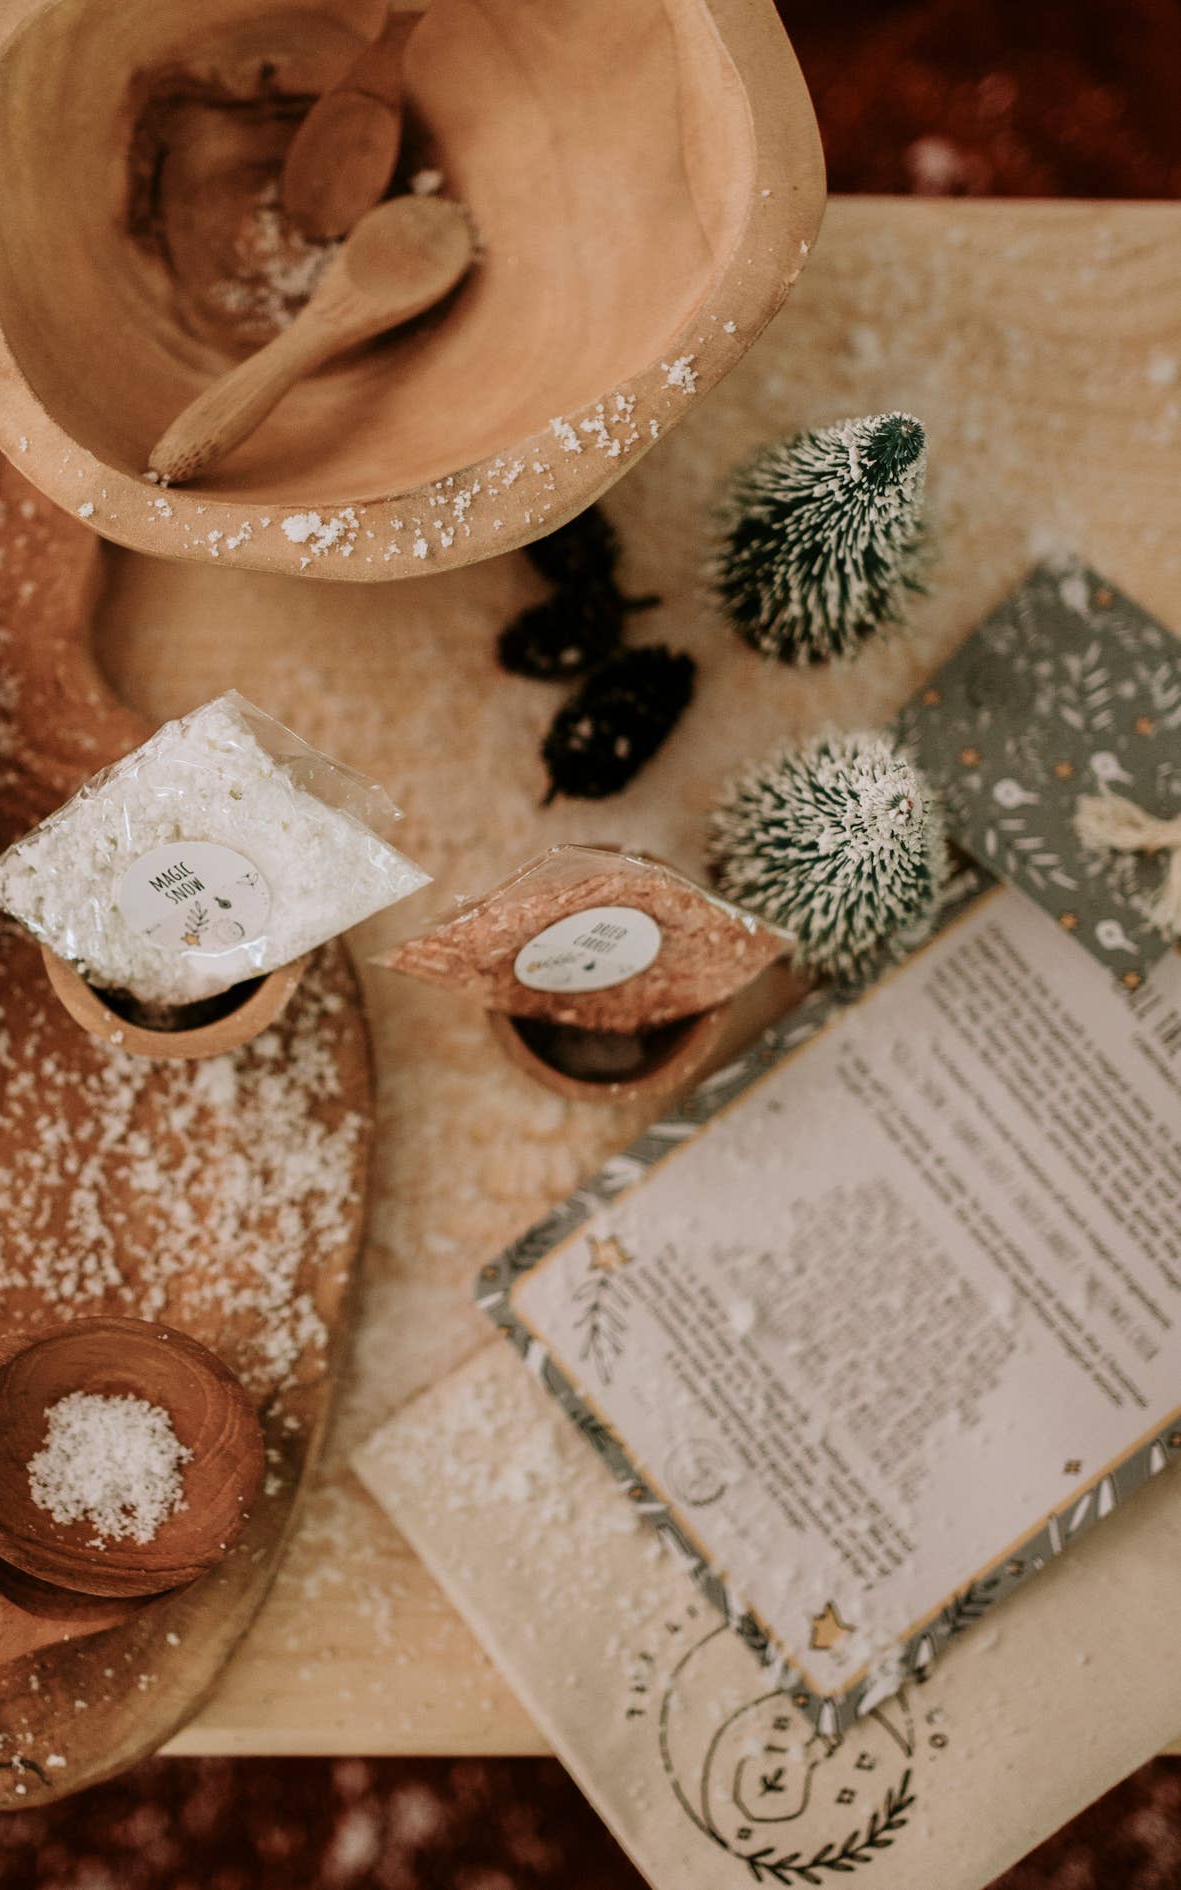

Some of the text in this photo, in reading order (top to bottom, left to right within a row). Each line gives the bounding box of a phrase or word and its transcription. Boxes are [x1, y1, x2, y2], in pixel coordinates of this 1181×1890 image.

[148, 861, 194, 892] MAGIC
[164, 876, 206, 905] SNOW
[590, 922, 628, 940] DRIED
